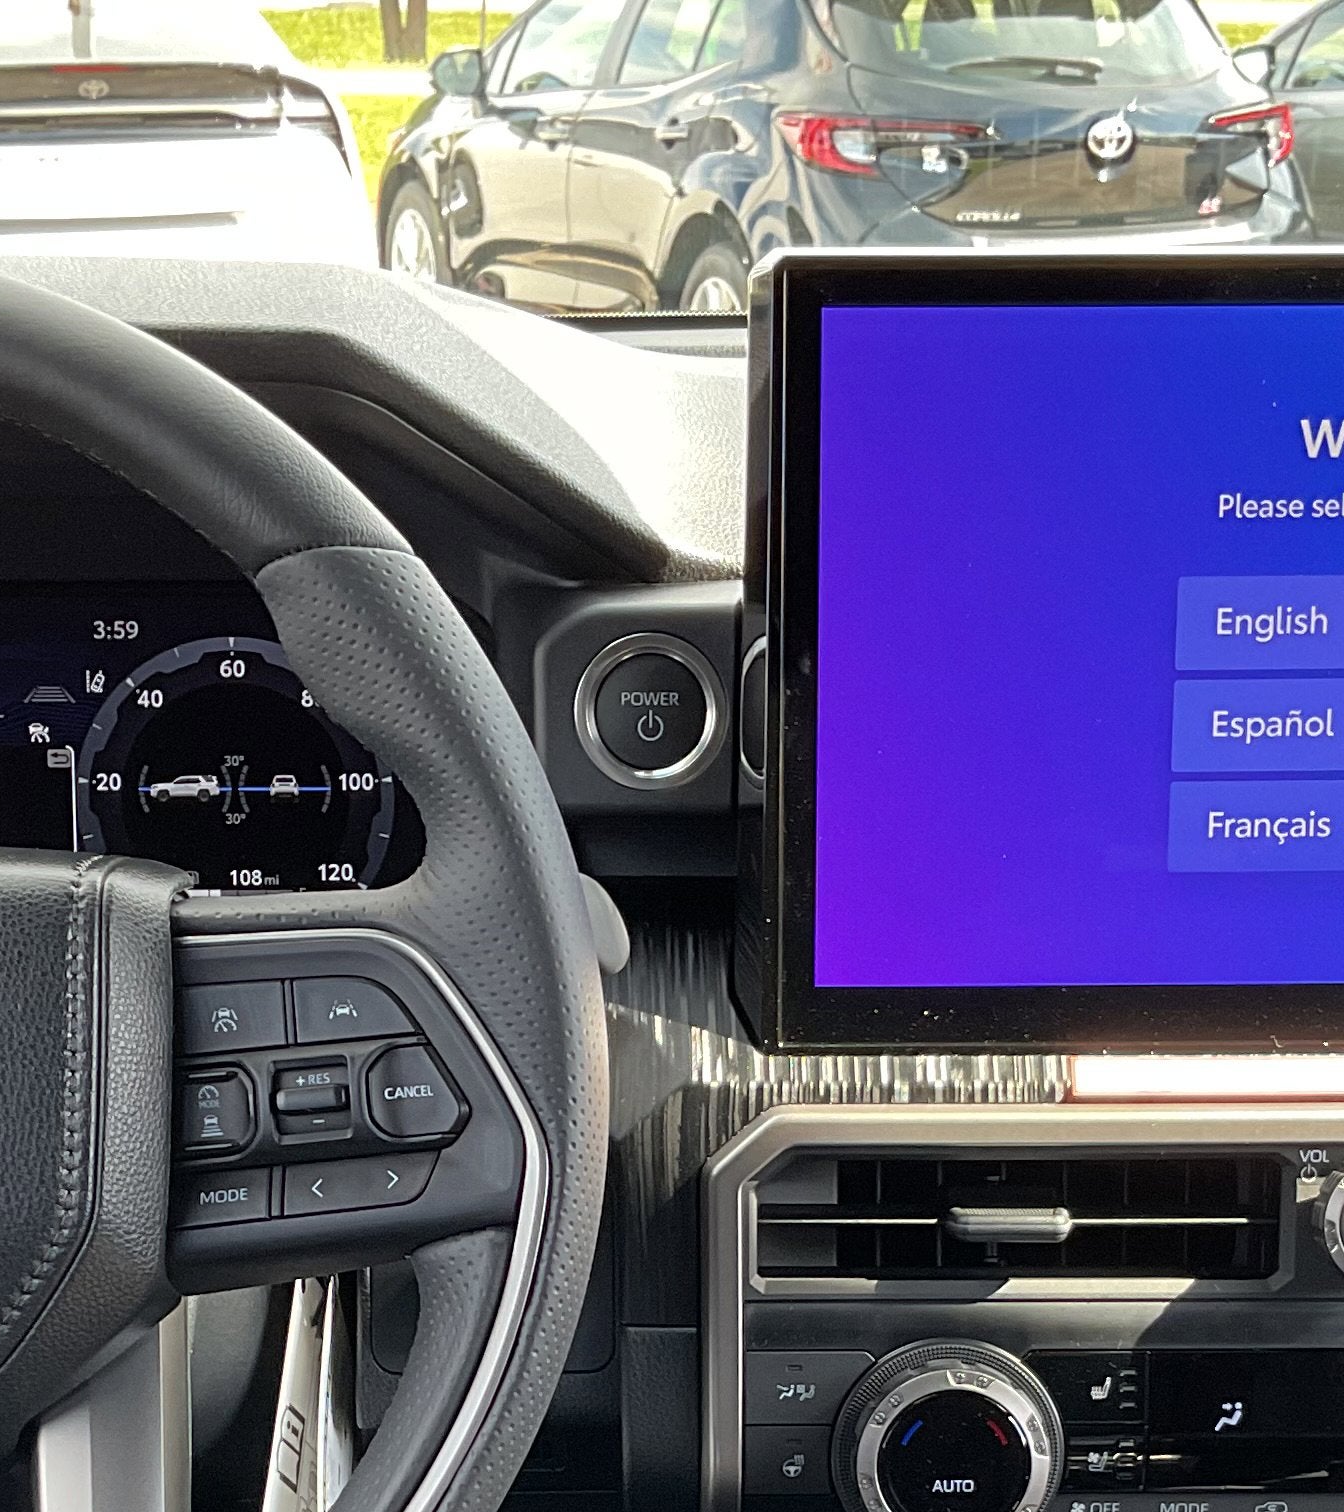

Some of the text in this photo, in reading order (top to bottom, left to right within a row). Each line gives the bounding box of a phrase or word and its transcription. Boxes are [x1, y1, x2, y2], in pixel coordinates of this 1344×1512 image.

[1218, 492, 1305, 519] Please
[93, 620, 139, 640] 3:59
[1216, 605, 1328, 643] English
[219, 659, 246, 678] 60
[138, 690, 164, 709] 40
[620, 691, 679, 706] POWER
[1212, 708, 1335, 745] Español
[97, 772, 122, 792] 20
[338, 772, 374, 792] 100
[1208, 810, 1331, 845] Français
[229, 869, 280, 886] 108 mi
[318, 863, 353, 883] 120
[384, 1084, 434, 1100] CANCEL
[1299, 1149, 1330, 1163] VOL
[199, 1187, 249, 1205] MODE
[931, 1479, 975, 1493] AUTO
